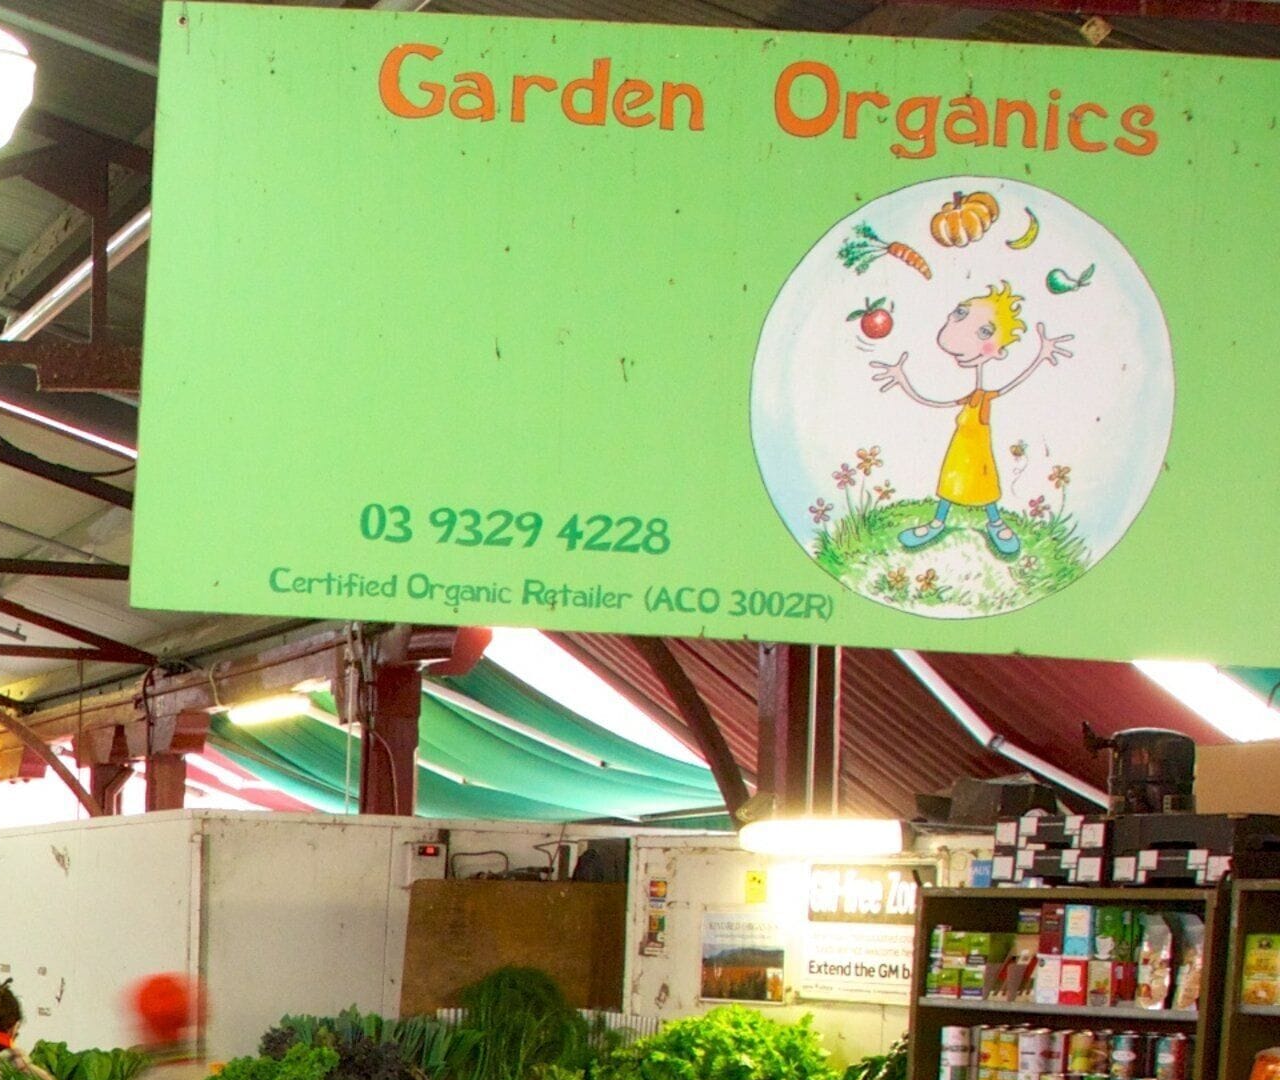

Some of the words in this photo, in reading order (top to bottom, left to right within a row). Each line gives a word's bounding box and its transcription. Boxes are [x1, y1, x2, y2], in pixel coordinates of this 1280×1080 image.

[378, 43, 705, 131] Garden
[773, 60, 1160, 160] Organics
[359, 503, 413, 544] 03
[427, 506, 544, 548] 9329
[554, 513, 671, 555] 4228
[268, 566, 398, 598] Certified
[406, 573, 512, 607] Organic
[521, 578, 633, 610] Retailer
[643, 585, 721, 616] (ACO
[729, 590, 835, 624] 3002R)
[808, 959, 852, 977] Extend
[854, 961, 876, 978] the
[878, 963, 900, 979] GM
